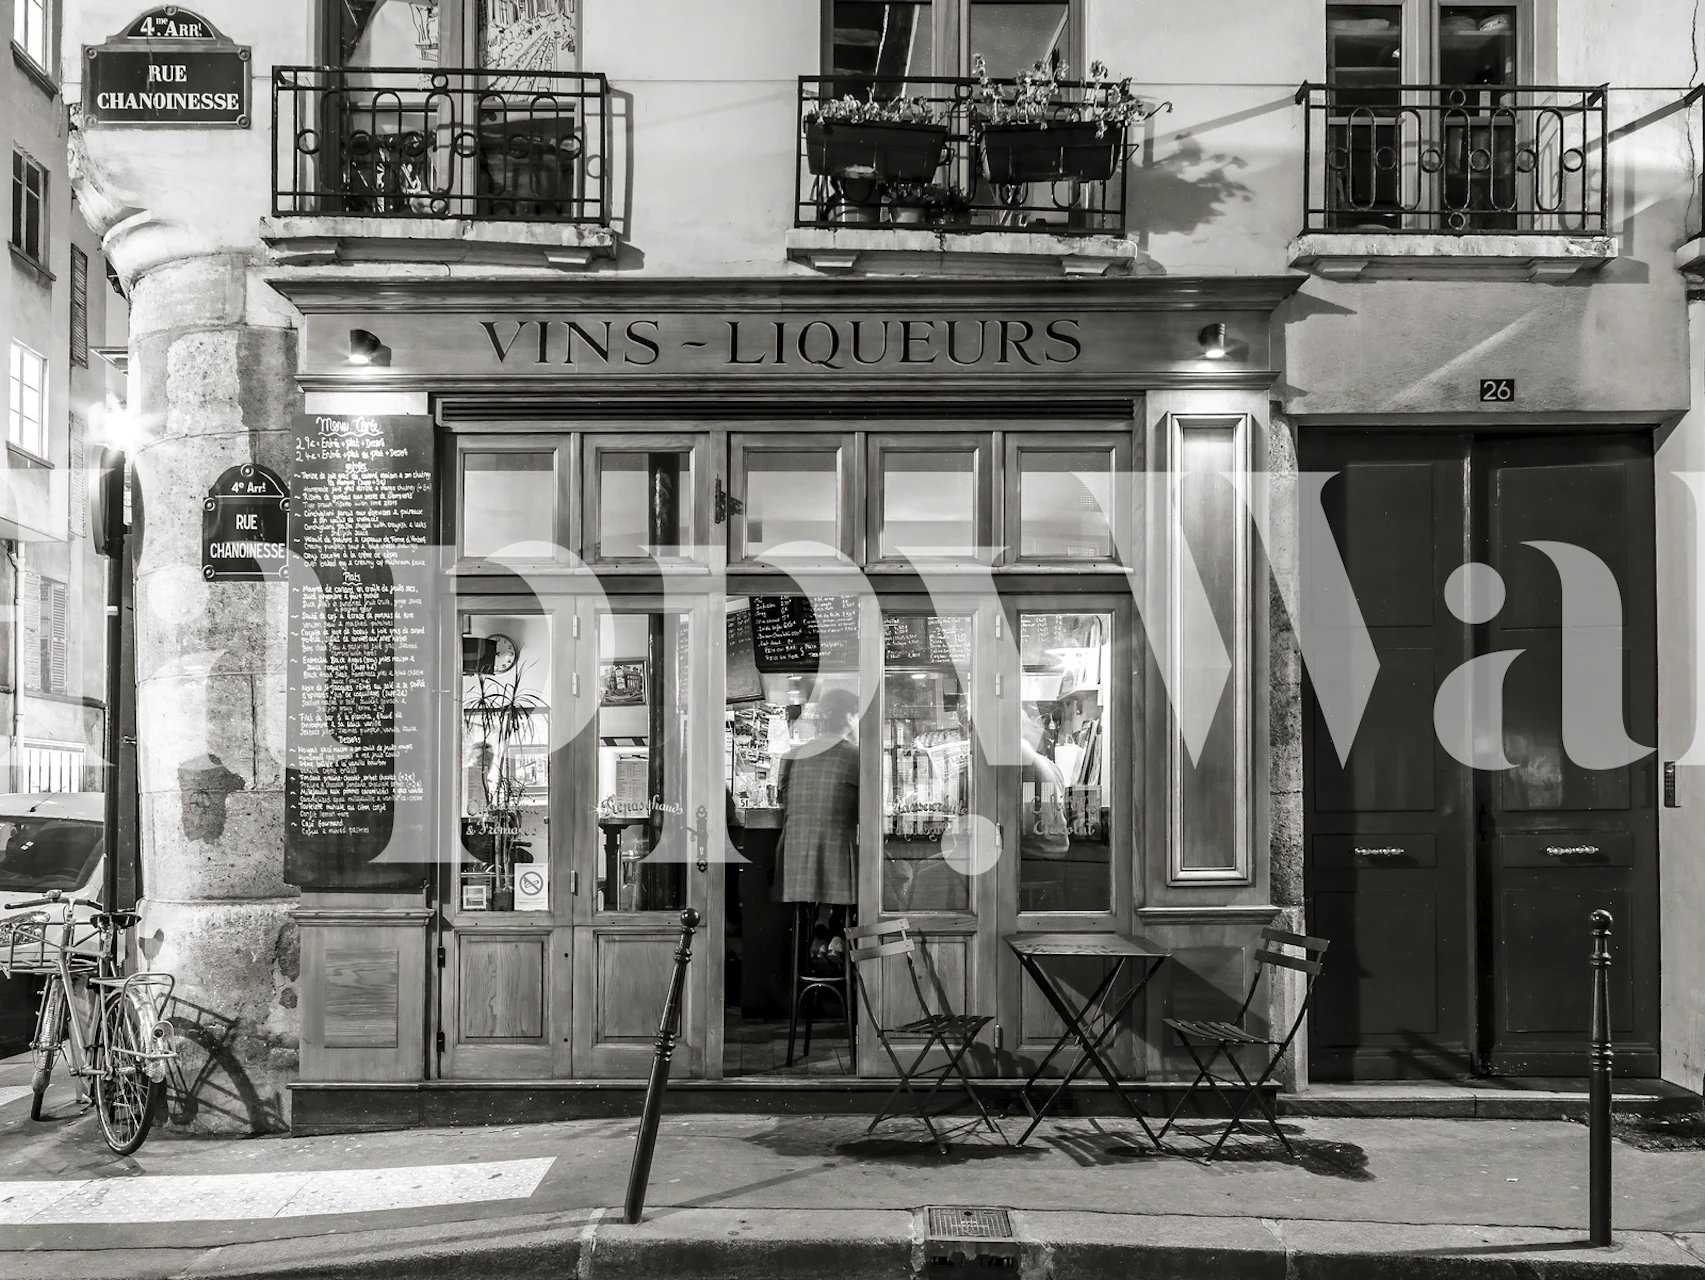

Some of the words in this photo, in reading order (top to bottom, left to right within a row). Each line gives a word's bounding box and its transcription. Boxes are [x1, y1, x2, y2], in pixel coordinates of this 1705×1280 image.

[148, 65, 187, 82] RUE
[97, 92, 239, 110] CHANOINESSE
[478, 320, 660, 367] VINS
[723, 320, 1082, 370] LIQUEURS
[1482, 380, 1510, 400] 26
[235, 514, 258, 530] RUE
[210, 542, 286, 559] CHANOINESSE
